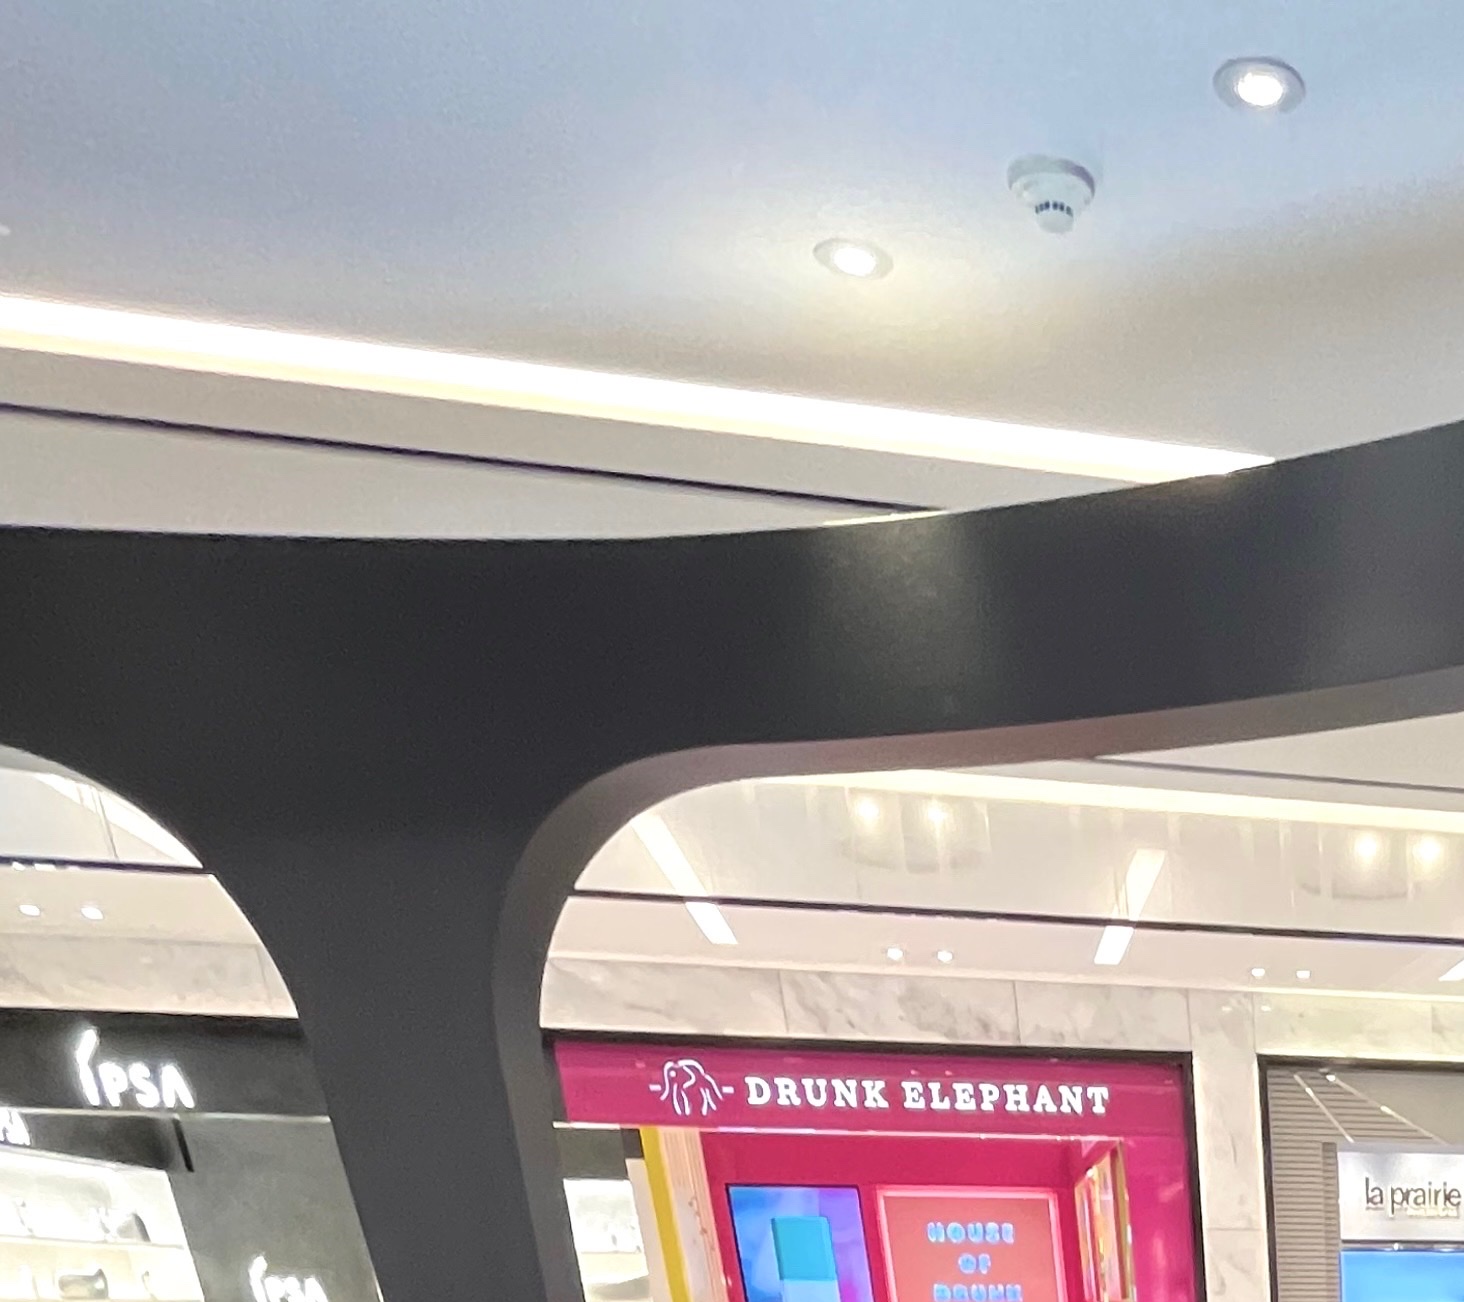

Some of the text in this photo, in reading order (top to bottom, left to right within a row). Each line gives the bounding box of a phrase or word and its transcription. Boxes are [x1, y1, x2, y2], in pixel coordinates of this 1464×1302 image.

[75, 1027, 196, 1108] IPSA
[744, 1076, 1110, 1115] DRUNK ELEPHANT
[1365, 1176, 1462, 1216] la prairie
[926, 1221, 1015, 1245] HOUSE
[957, 1252, 992, 1275] OF
